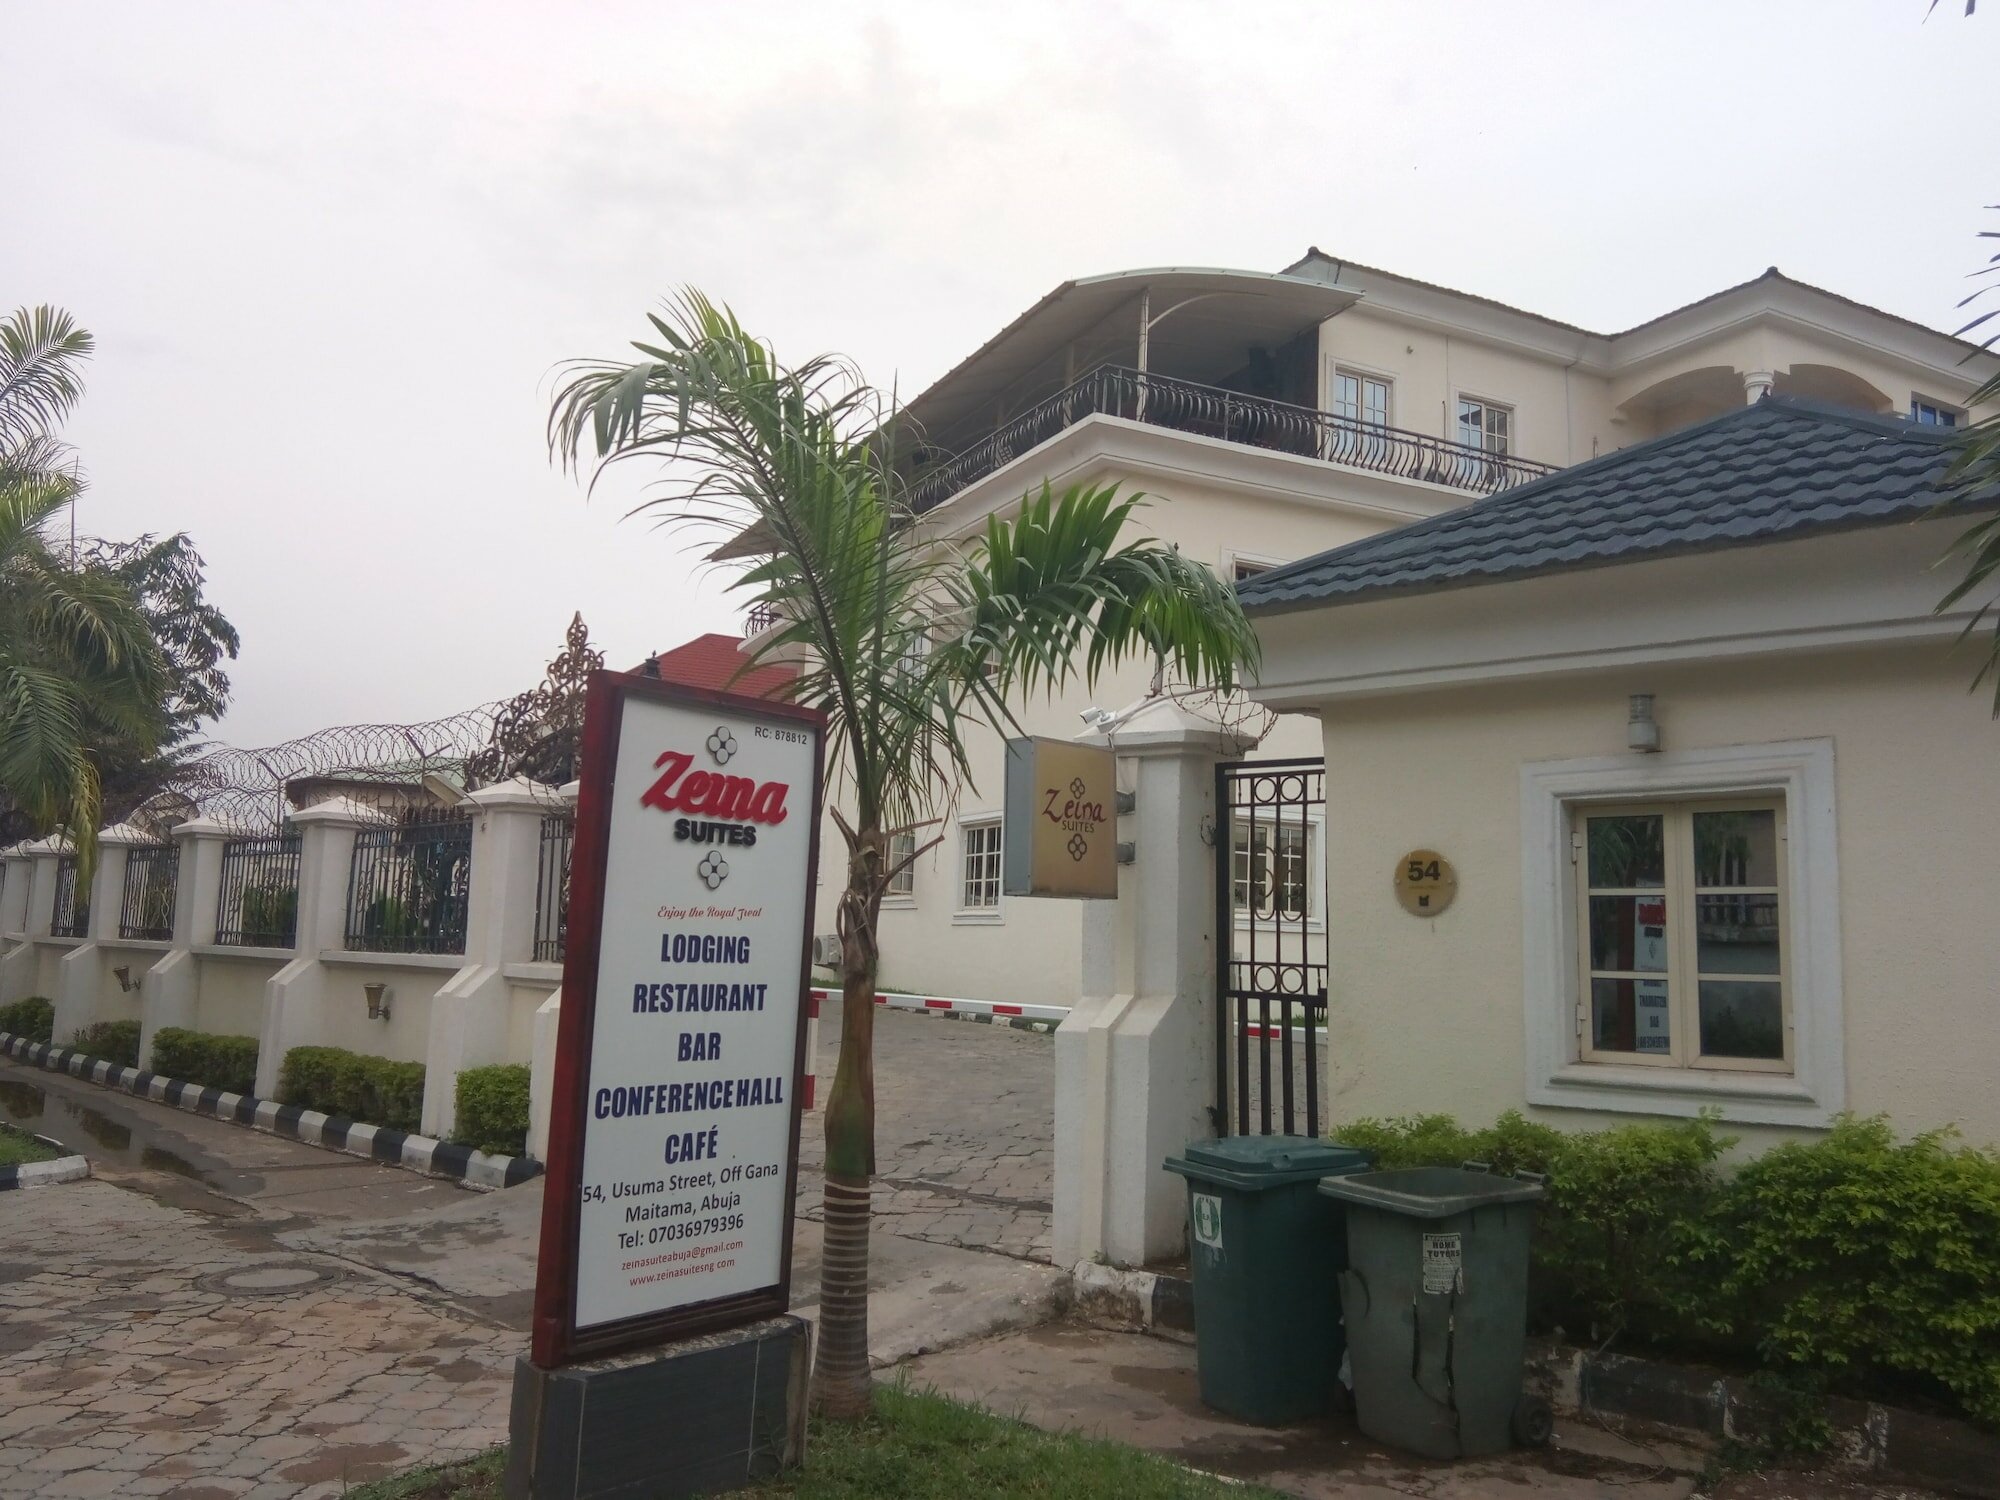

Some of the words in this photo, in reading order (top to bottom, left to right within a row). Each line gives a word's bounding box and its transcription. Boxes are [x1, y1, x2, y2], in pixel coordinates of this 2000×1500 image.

[754, 726, 772, 739] RC:
[775, 730, 807, 745] 878812
[1042, 788, 1108, 823] Zeina
[674, 818, 757, 846] SUITES
[1062, 820, 1095, 833] SUITES
[1408, 860, 1440, 881] 54
[657, 906, 686, 920] Enjoy
[688, 906, 704, 918] the
[706, 906, 736, 919] Royal
[661, 933, 750, 964] LODGING
[633, 983, 767, 1013] RESTAURANT
[678, 1032, 721, 1062] BAR
[594, 1080, 734, 1120] CONFERENCE
[736, 1077, 783, 1107] HALL
[664, 1125, 718, 1164] CAFÉ
[582, 1185, 606, 1204] 54,
[612, 1180, 664, 1199] Usuma
[669, 1172, 716, 1191] Street,
[720, 1166, 743, 1184] Off
[745, 1163, 779, 1180] Gana
[625, 1200, 696, 1223] Maitama,
[700, 1191, 741, 1212] Abuja
[618, 1233, 644, 1249] Tel:
[648, 1213, 744, 1245] 07036979396
[1433, 1241, 1456, 1249] HOME
[629, 1259, 735, 1287] www.zeinasuitesngcom
